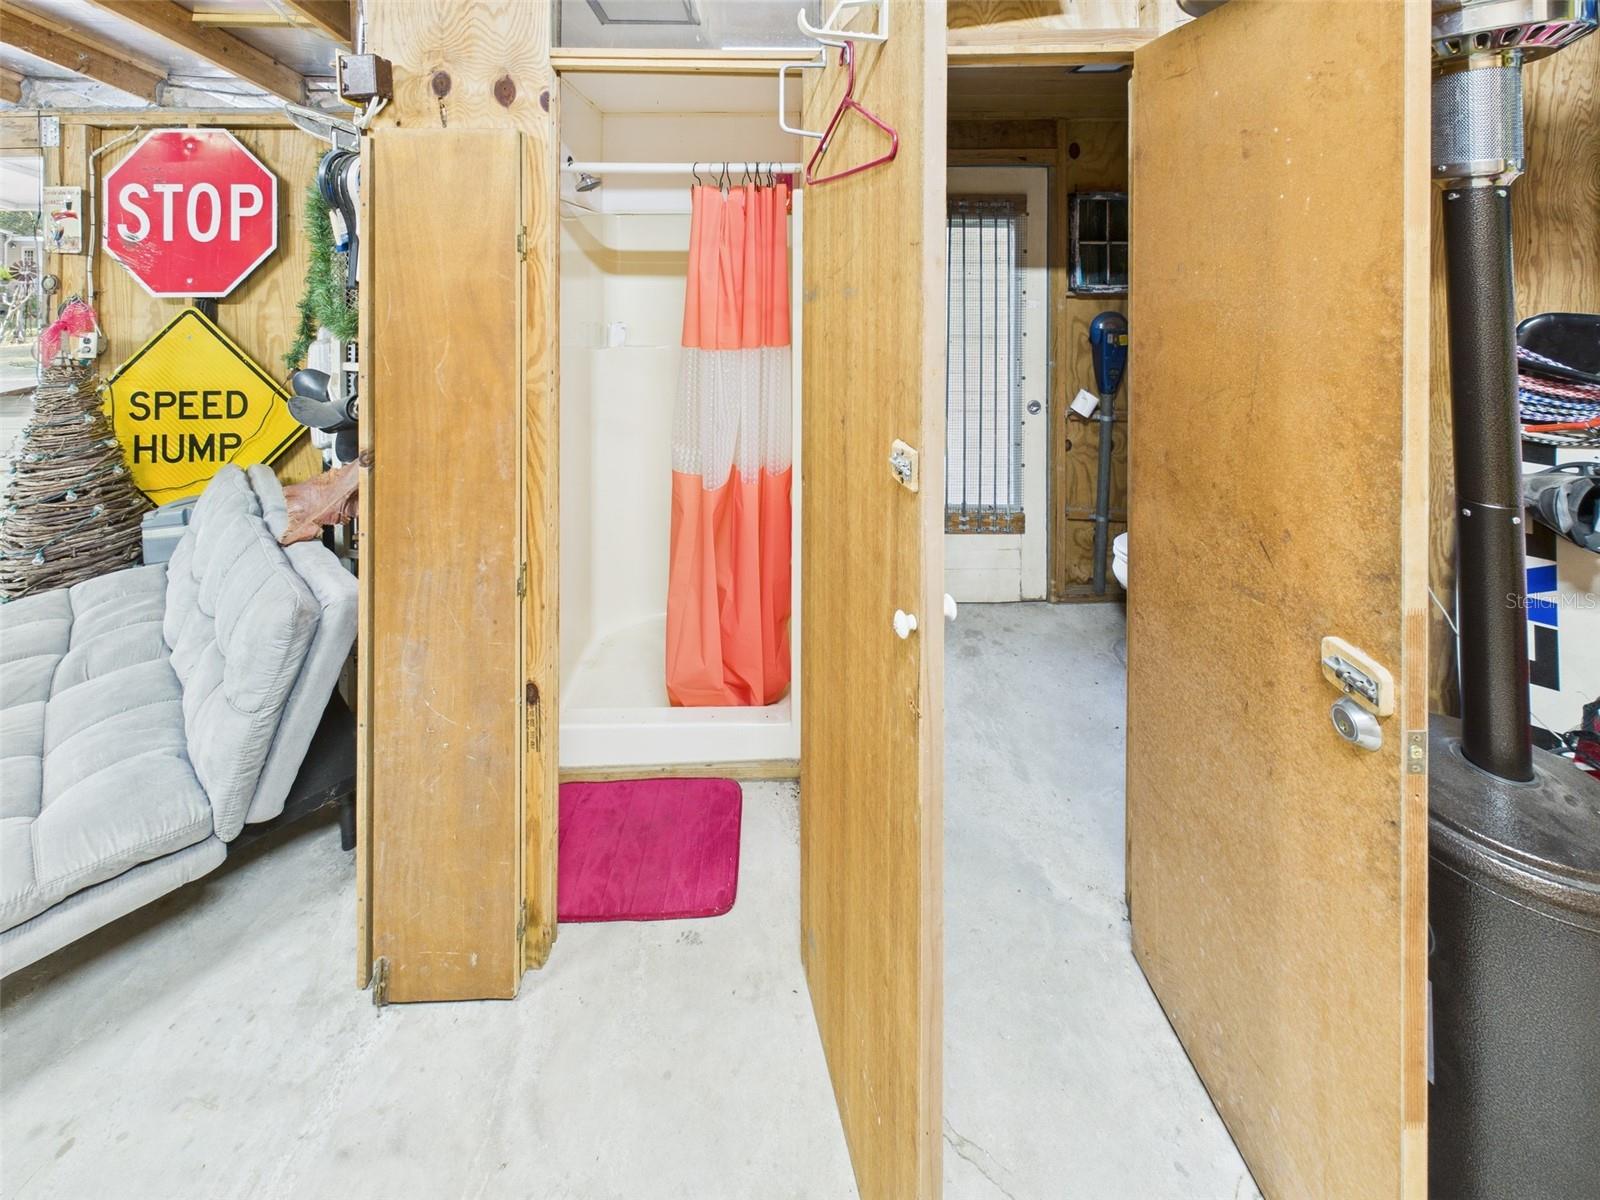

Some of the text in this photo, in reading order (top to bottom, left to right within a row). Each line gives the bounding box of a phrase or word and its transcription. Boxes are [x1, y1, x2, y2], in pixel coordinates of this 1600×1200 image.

[117, 182, 264, 243] STOP
[128, 390, 249, 422] SPEED
[133, 432, 242, 464] HUMP
